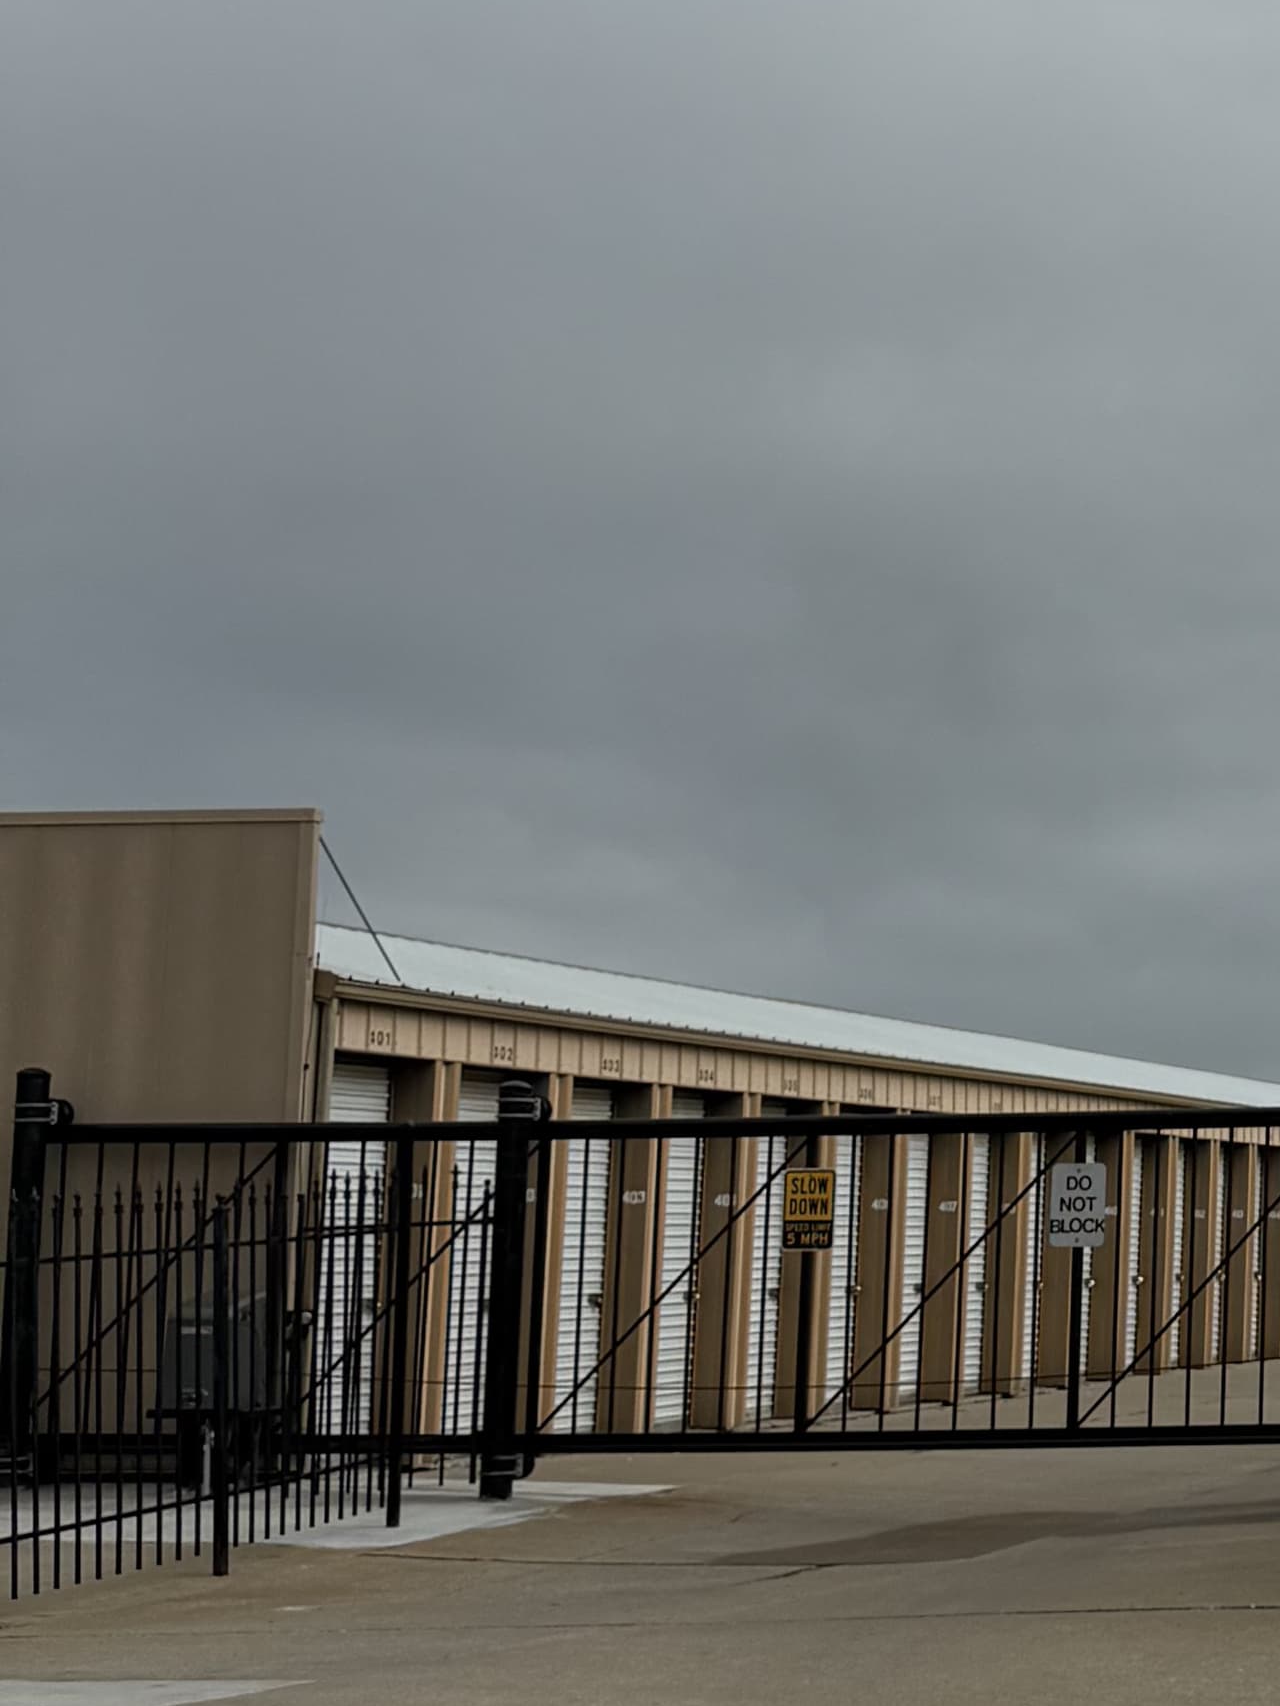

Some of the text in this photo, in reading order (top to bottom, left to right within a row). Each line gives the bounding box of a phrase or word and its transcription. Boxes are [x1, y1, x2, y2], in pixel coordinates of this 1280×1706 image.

[791, 1177, 828, 1194] SLOW
[1066, 1175, 1092, 1191] DO
[790, 1198, 828, 1215] DOWN
[1059, 1196, 1098, 1212] NOT
[1049, 1217, 1105, 1233] BLOCK
[786, 1232, 829, 1246] 5 MPH
